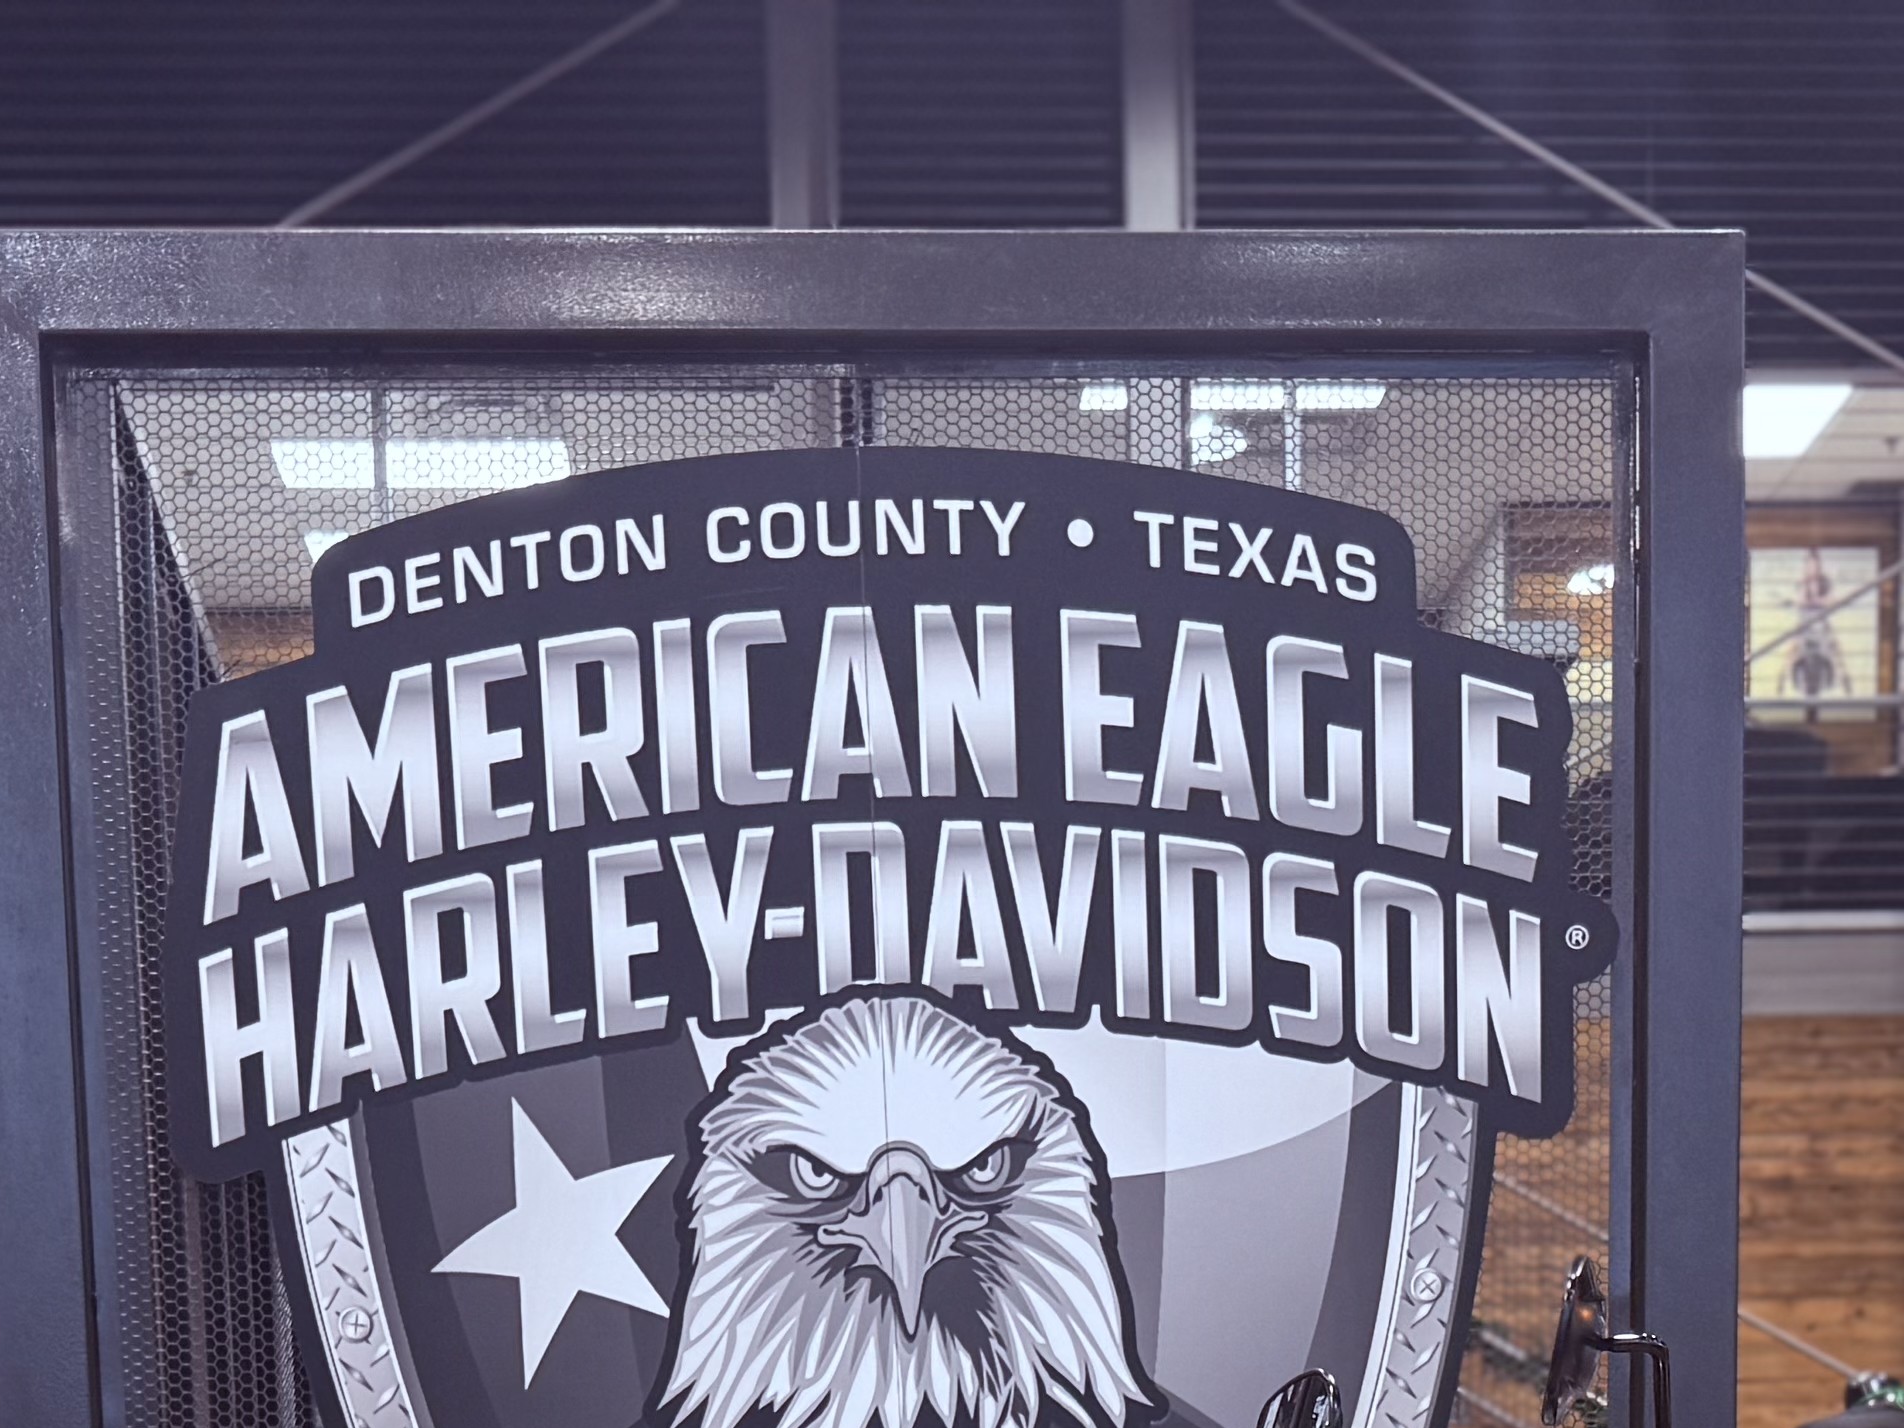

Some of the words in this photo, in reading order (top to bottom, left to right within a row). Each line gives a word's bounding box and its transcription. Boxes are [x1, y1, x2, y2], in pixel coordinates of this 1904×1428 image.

[348, 513, 666, 629] DENTON
[706, 498, 1026, 565] COUNTY
[1133, 509, 1379, 603] TEXAS
[202, 604, 1019, 926] AMERICAN
[1059, 608, 1540, 884] EAGLE
[198, 819, 1543, 1148] HARLEY-DAVIDSON
